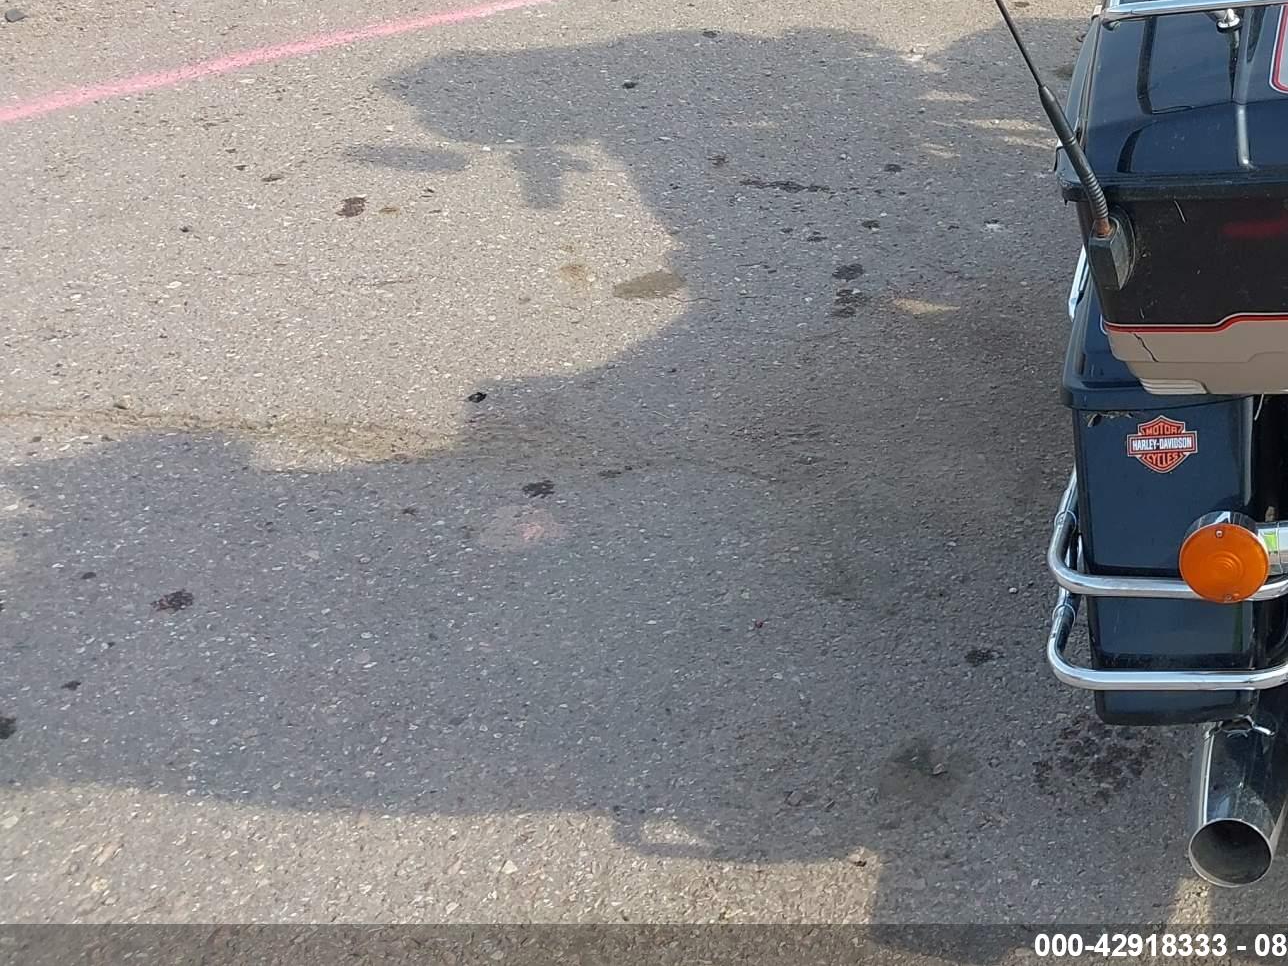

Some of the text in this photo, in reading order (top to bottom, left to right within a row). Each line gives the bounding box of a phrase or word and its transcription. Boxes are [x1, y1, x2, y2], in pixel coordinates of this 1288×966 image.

[1145, 422, 1178, 436] MOTOR
[1132, 436, 1192, 451] HARLEY-DAVIDSON
[1146, 452, 1179, 467] CYCLES
